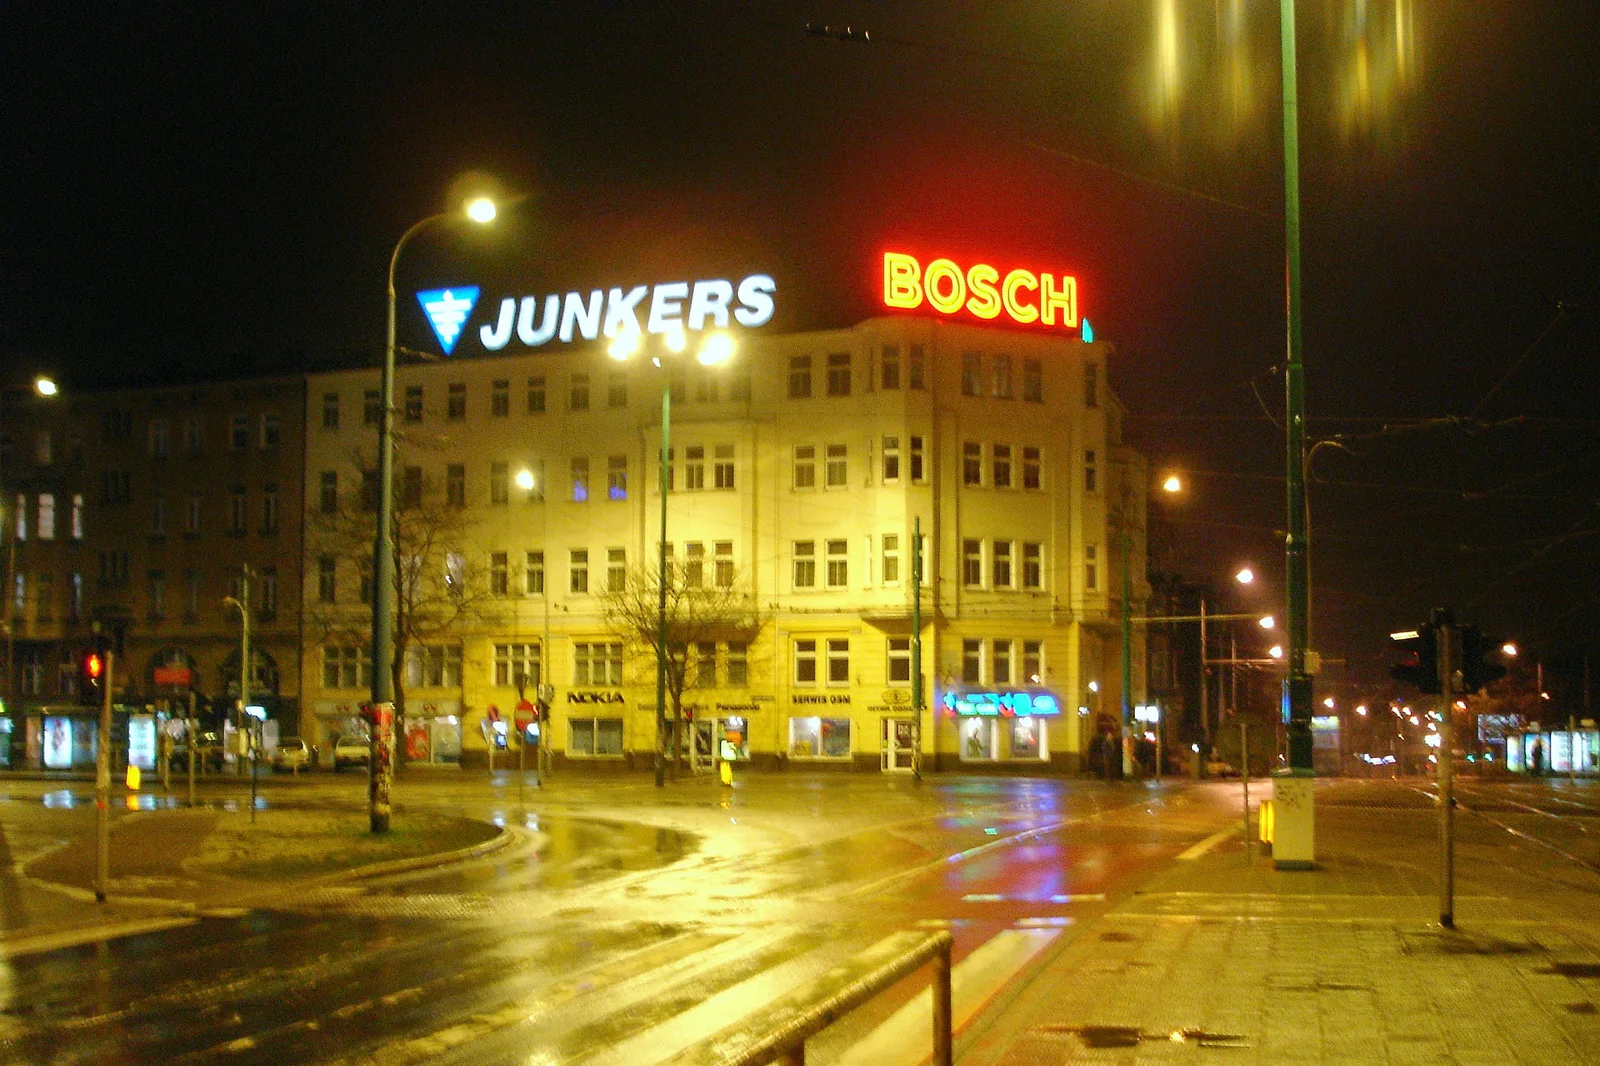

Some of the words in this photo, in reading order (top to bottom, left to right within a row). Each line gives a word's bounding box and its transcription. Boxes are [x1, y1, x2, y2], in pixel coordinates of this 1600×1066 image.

[480, 274, 777, 350] JUNKERS
[884, 252, 1077, 327] BOSCH
[567, 691, 625, 704] NOKIA
